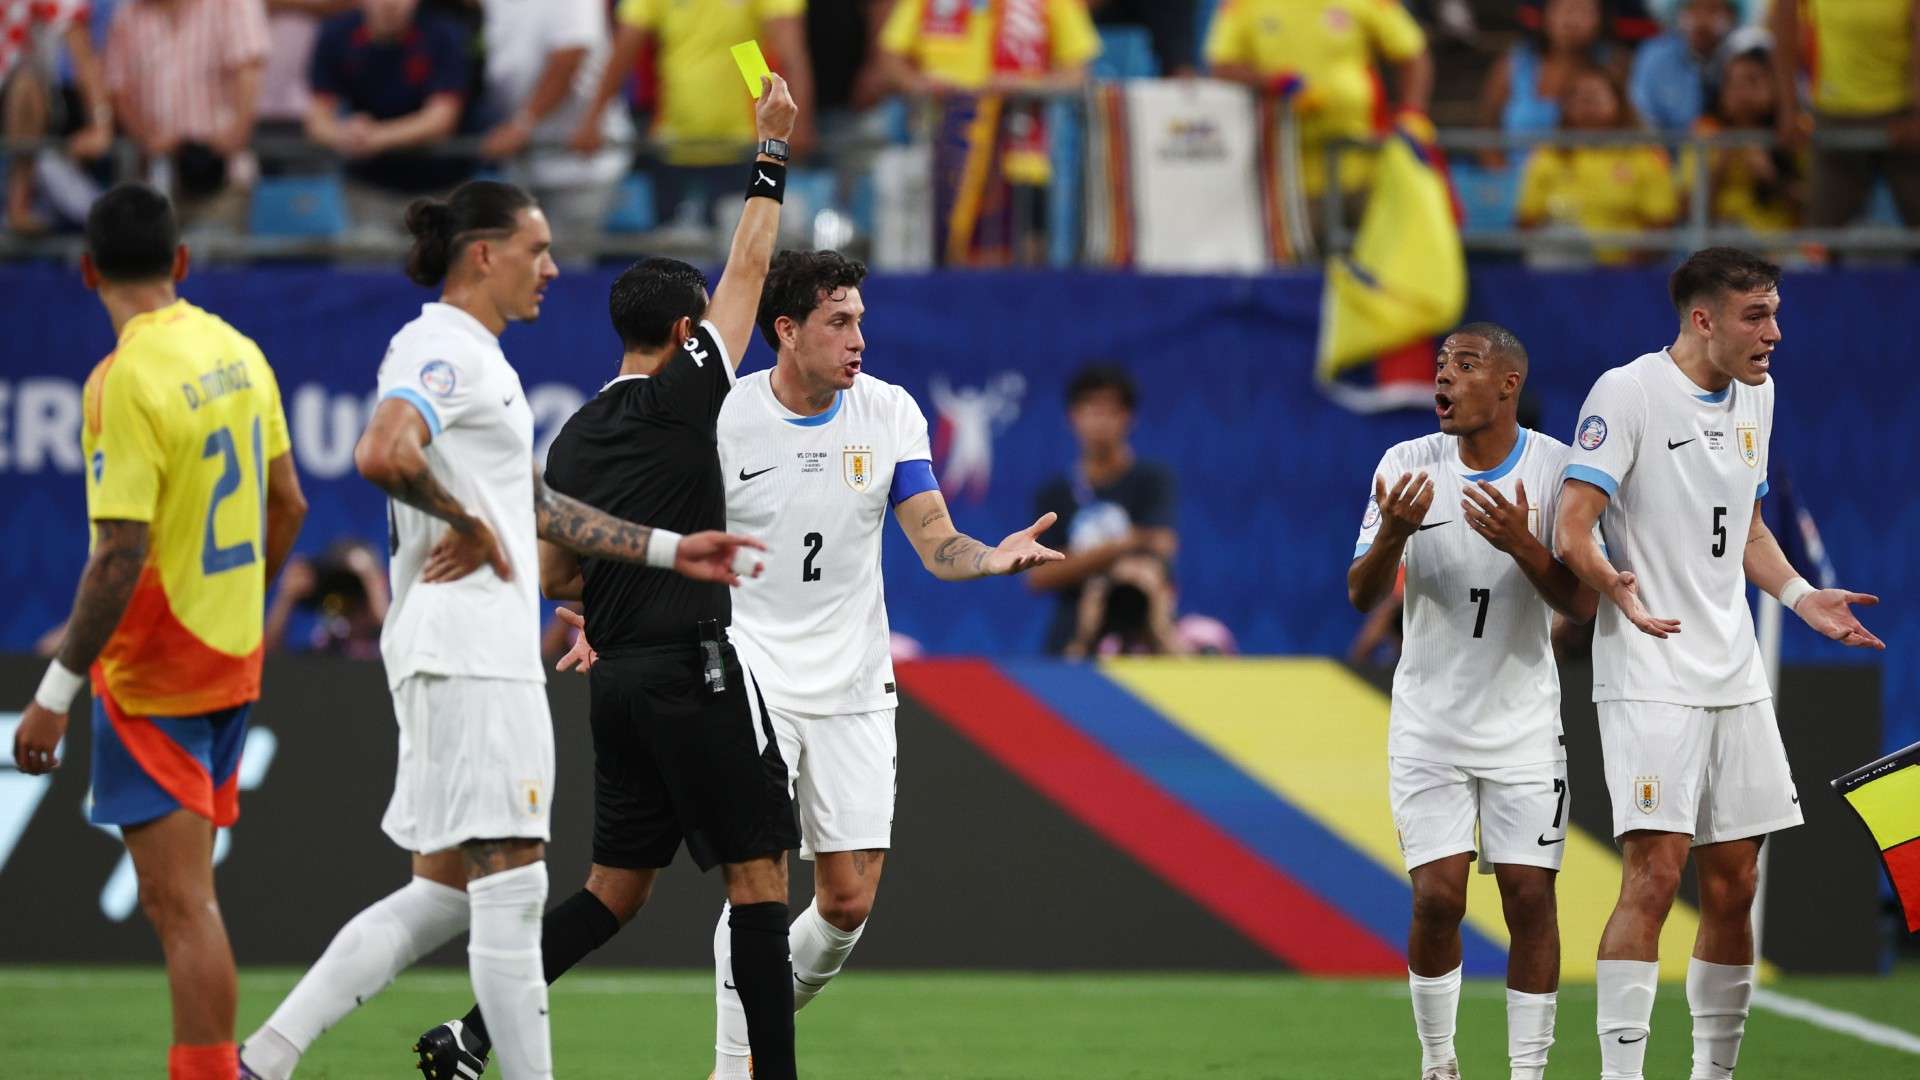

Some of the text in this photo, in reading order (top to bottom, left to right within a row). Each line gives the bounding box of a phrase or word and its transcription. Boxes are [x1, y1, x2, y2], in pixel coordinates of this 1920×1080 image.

[803, 532, 823, 582] 2
[1712, 506, 1727, 558] 5
[1470, 588, 1490, 639] 7
[1552, 778, 1566, 829] 7
